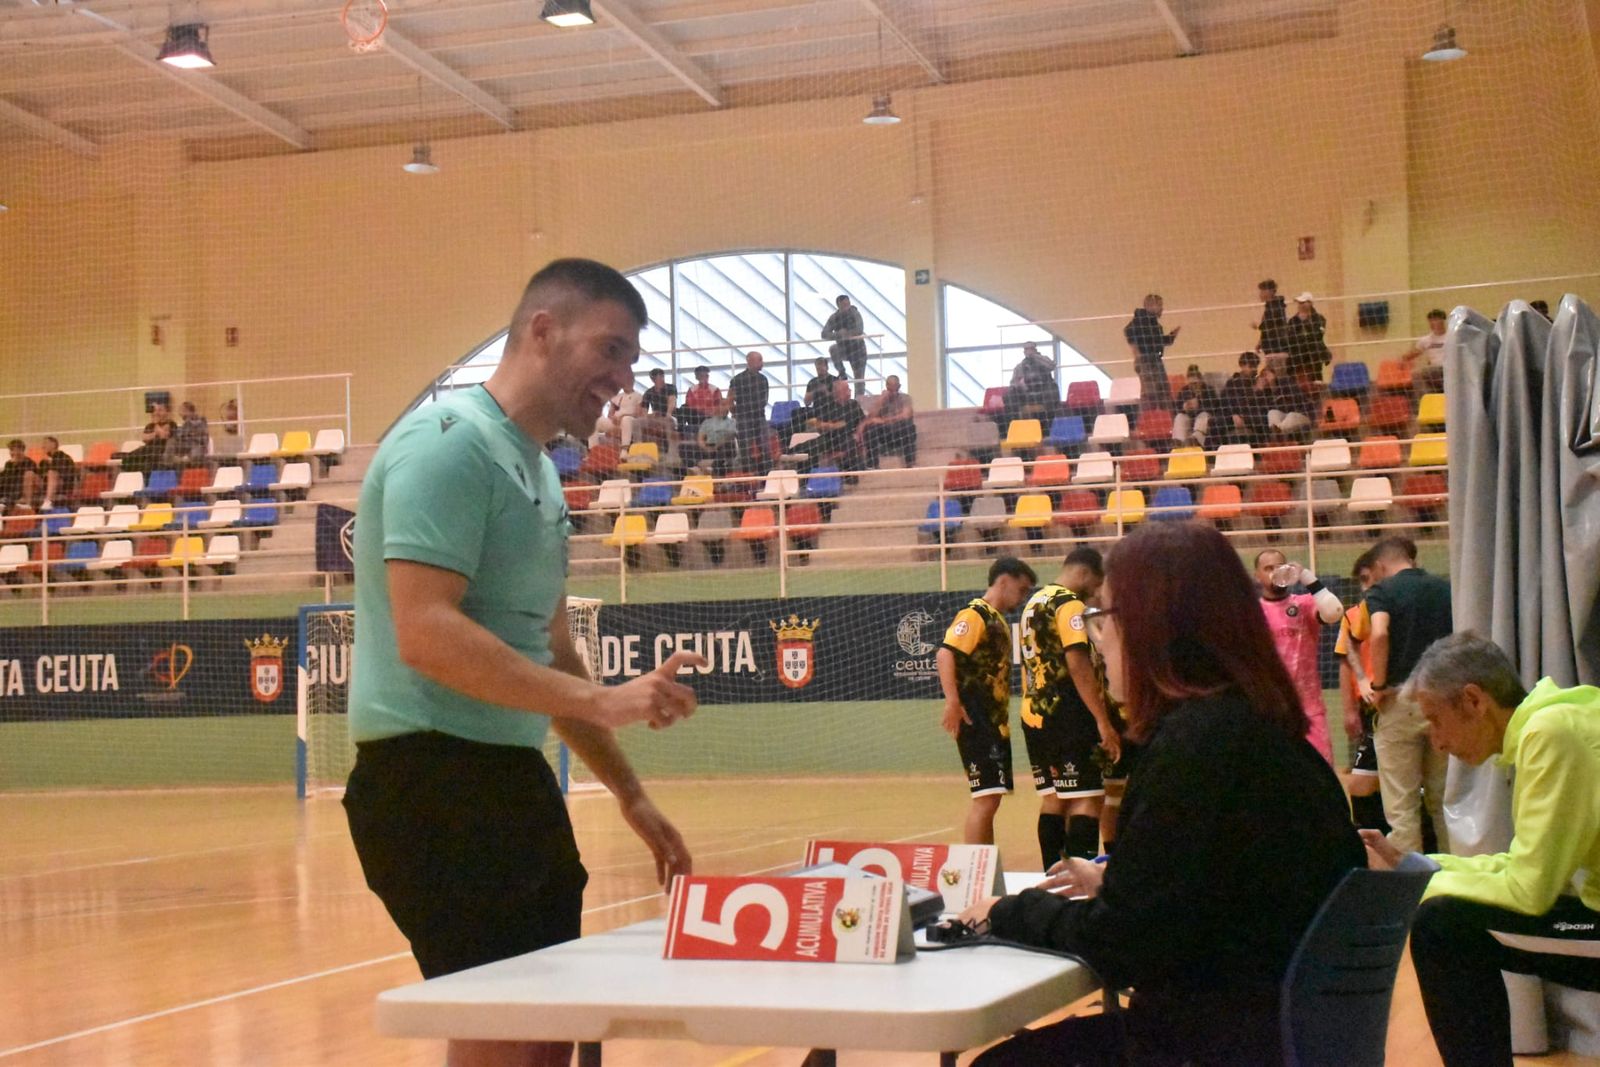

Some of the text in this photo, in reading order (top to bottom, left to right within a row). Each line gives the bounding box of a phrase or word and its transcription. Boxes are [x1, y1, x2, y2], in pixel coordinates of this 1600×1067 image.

[36, 653, 119, 693] CEUTA
[602, 635, 641, 677] DE
[654, 631, 756, 675] CEUTA
[682, 883, 789, 951] 5
[795, 880, 828, 957] ACUMULATIVA
